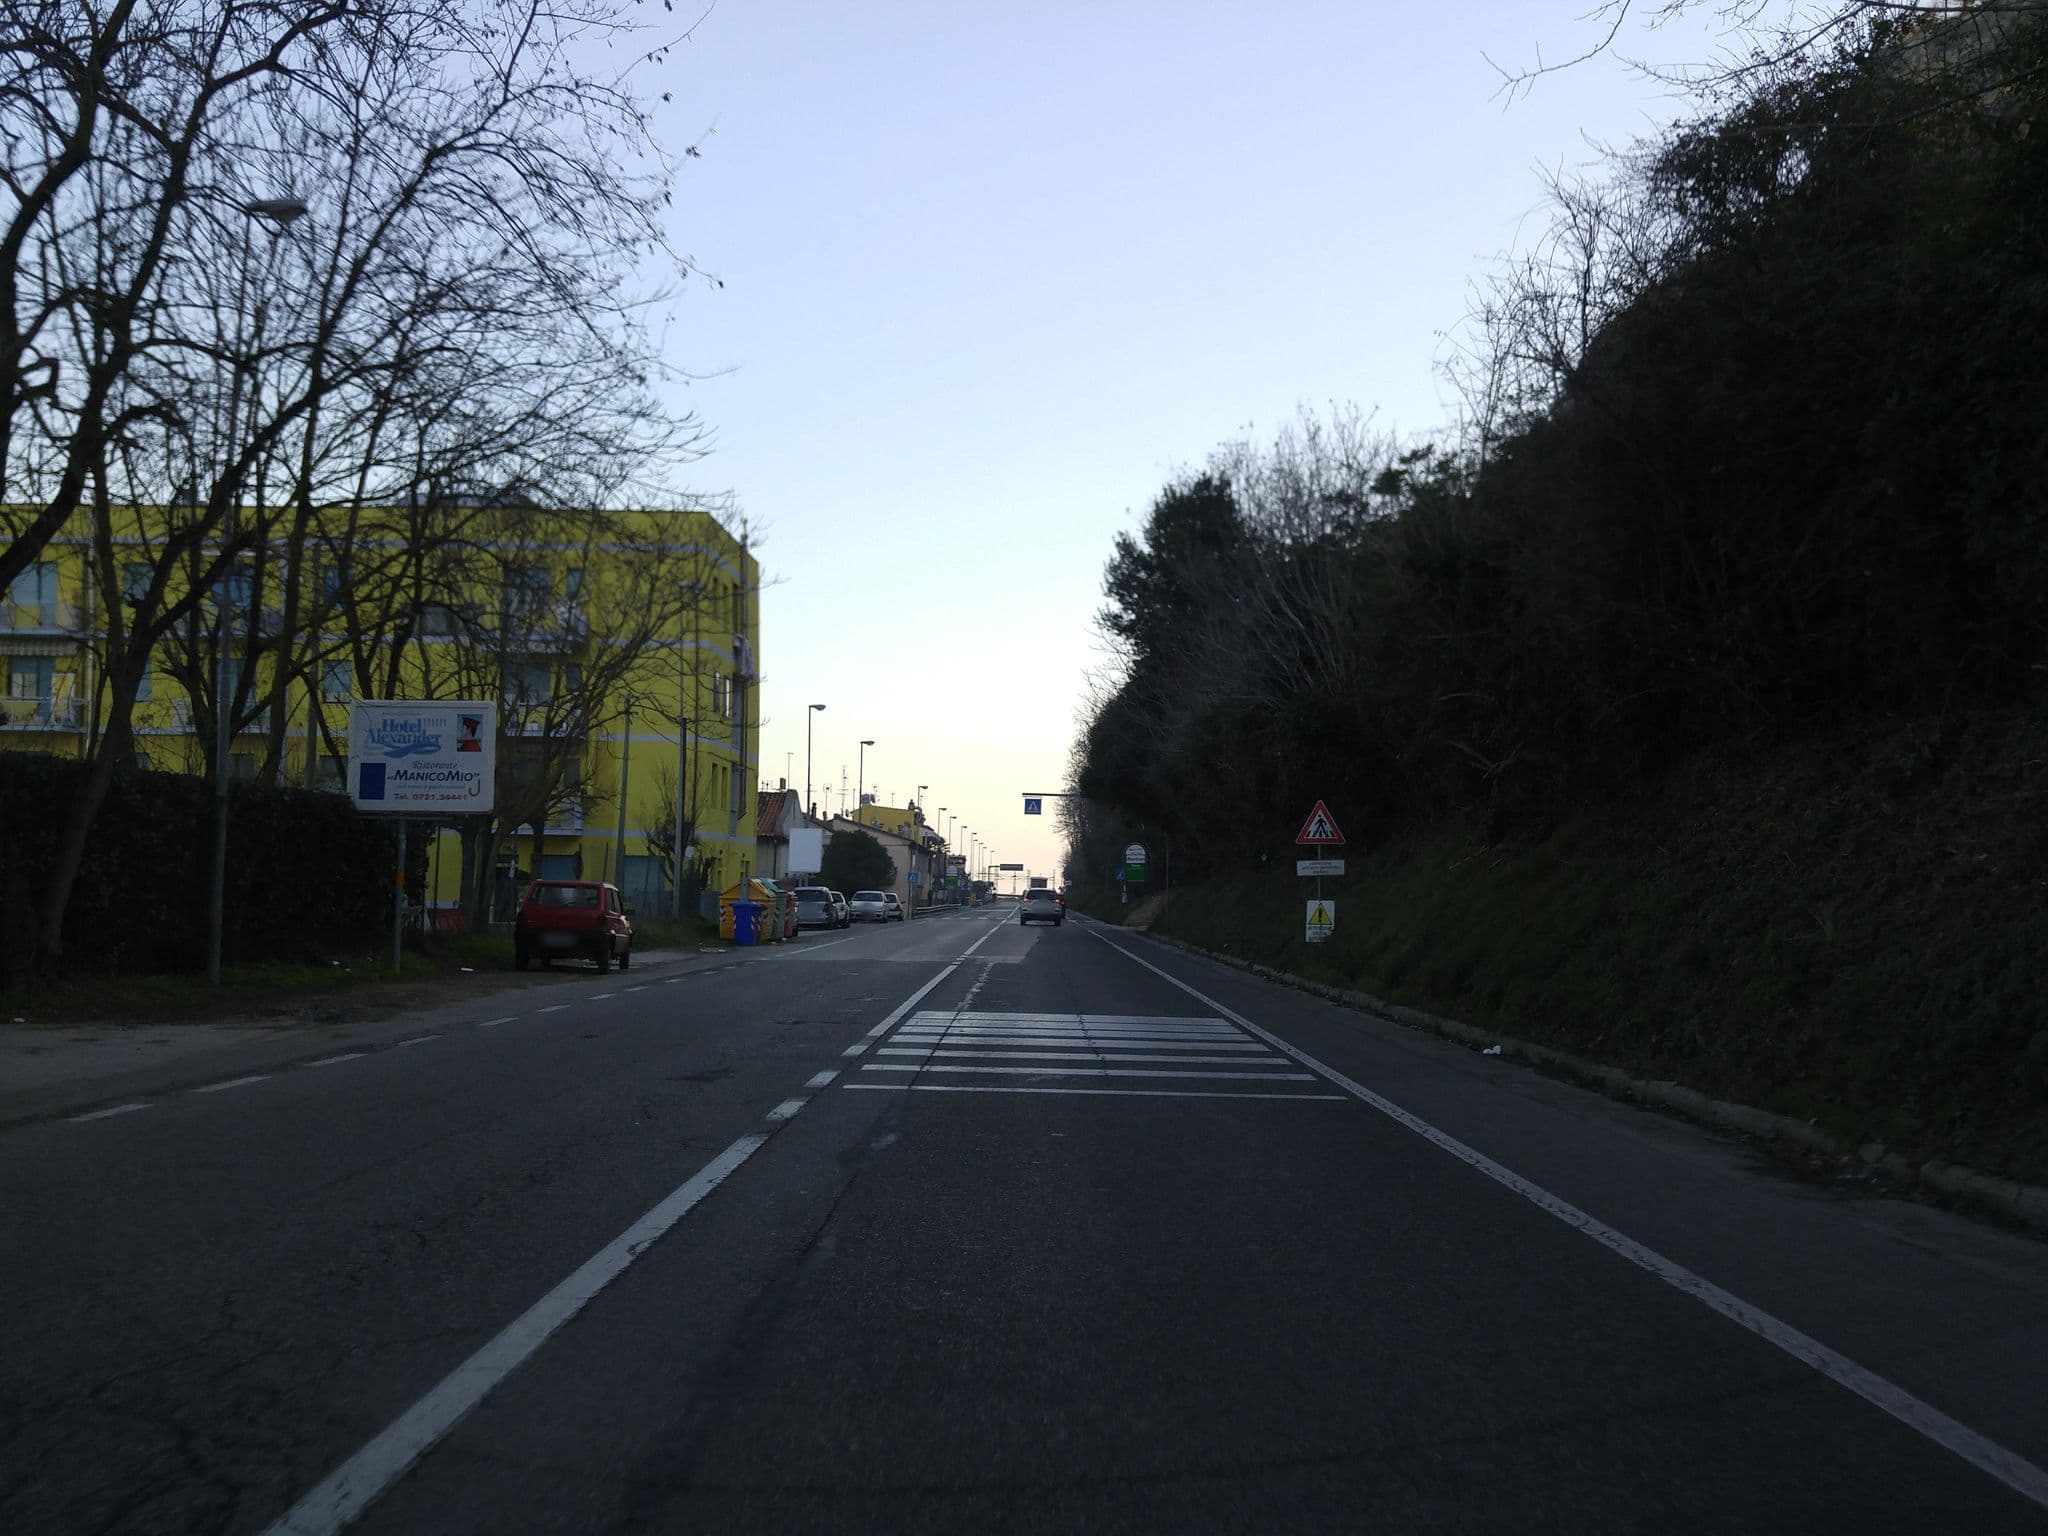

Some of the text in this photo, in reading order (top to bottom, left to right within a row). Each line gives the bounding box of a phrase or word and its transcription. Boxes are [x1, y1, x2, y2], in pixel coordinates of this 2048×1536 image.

[382, 718, 422, 733] Hotel
[367, 728, 442, 744] Alexander
[413, 761, 458, 770] Ristorante
